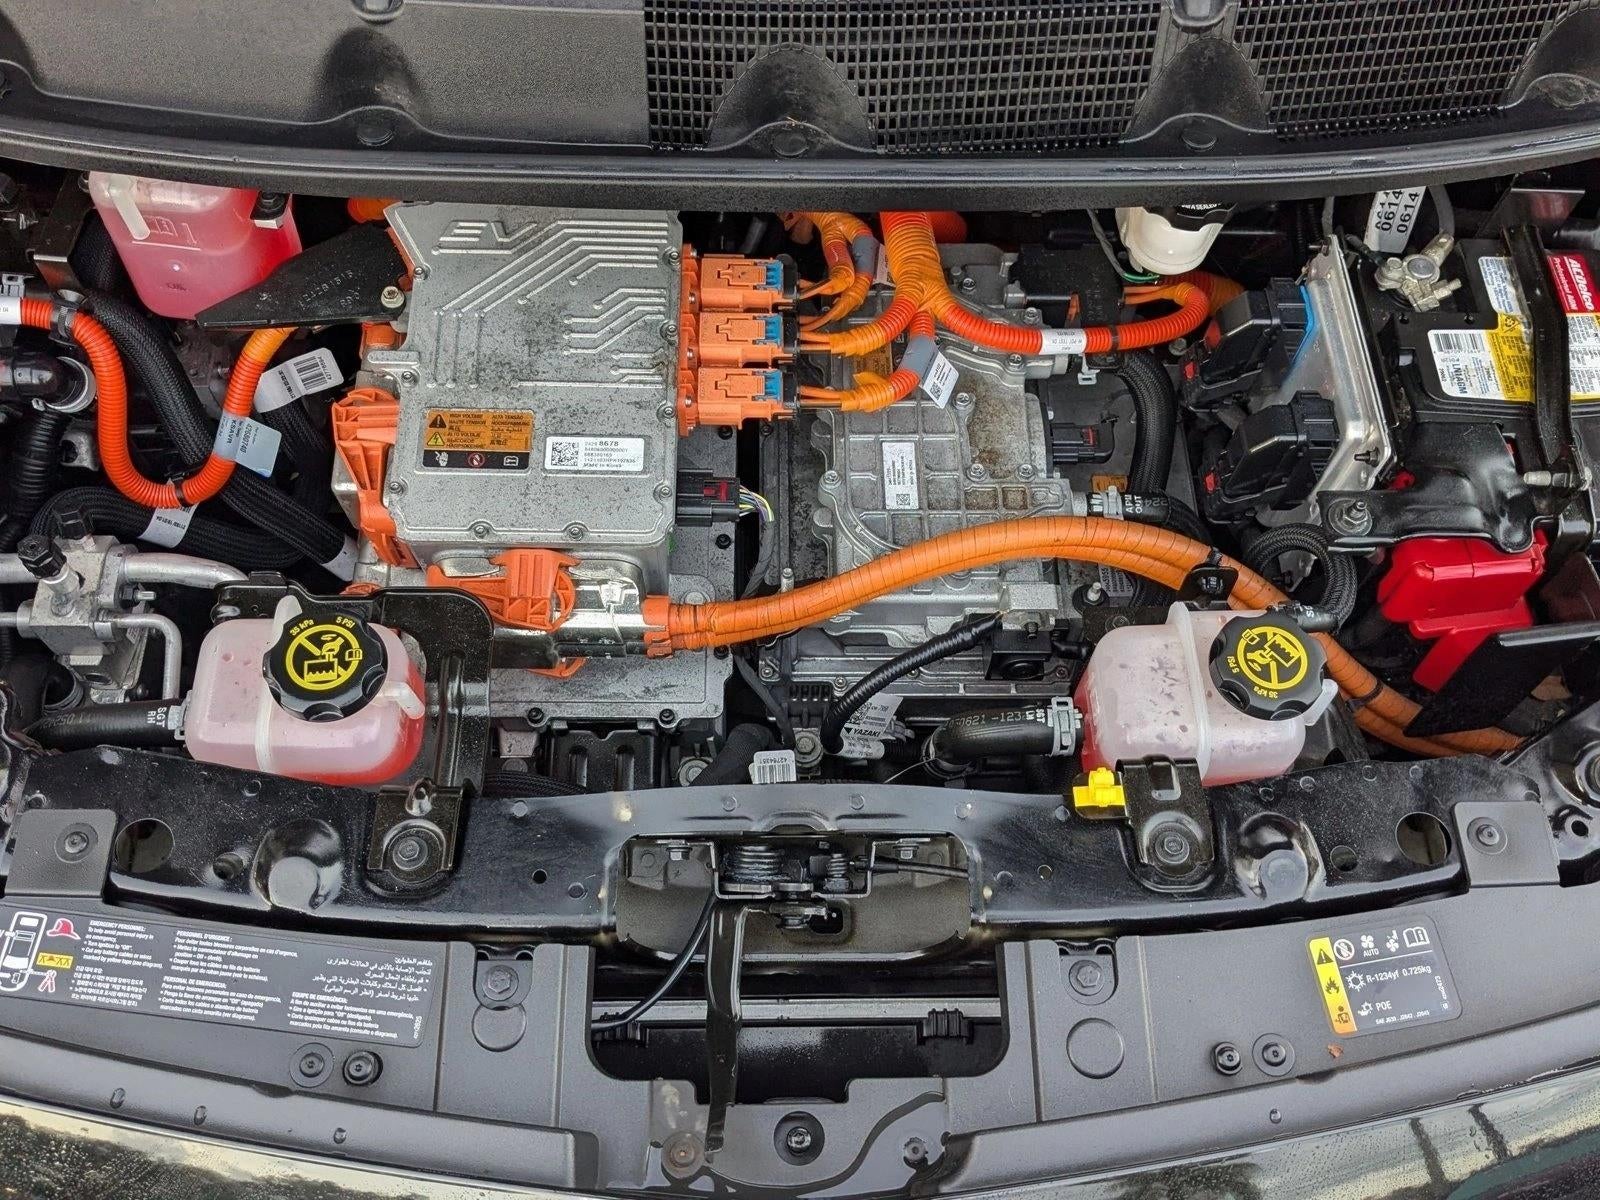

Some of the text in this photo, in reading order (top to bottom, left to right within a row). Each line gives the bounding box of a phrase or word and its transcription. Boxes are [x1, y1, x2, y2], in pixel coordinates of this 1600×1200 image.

[1381, 190, 1402, 231] 0614
[1397, 192, 1419, 232] 0614
[1554, 258, 1578, 310] Professional AGM
[1569, 258, 1594, 310] ACDelco
[1125, 494, 1134, 514] APU
[1135, 495, 1143, 514] OUT
[290, 619, 314, 636] 35 kPa
[342, 618, 356, 628] PSI
[1227, 656, 1238, 668] PSI
[1254, 686, 1268, 698] kPa
[147, 711, 157, 724] RH
[156, 707, 167, 727] SGT
[853, 728, 880, 737] YAZAKI
[90, 920, 116, 928] EMERGENCY
[1364, 948, 1379, 957] AUTO
[1366, 966, 1432, 983] R-1234yf 0.725kg
[1375, 1000, 1392, 1011] POE
